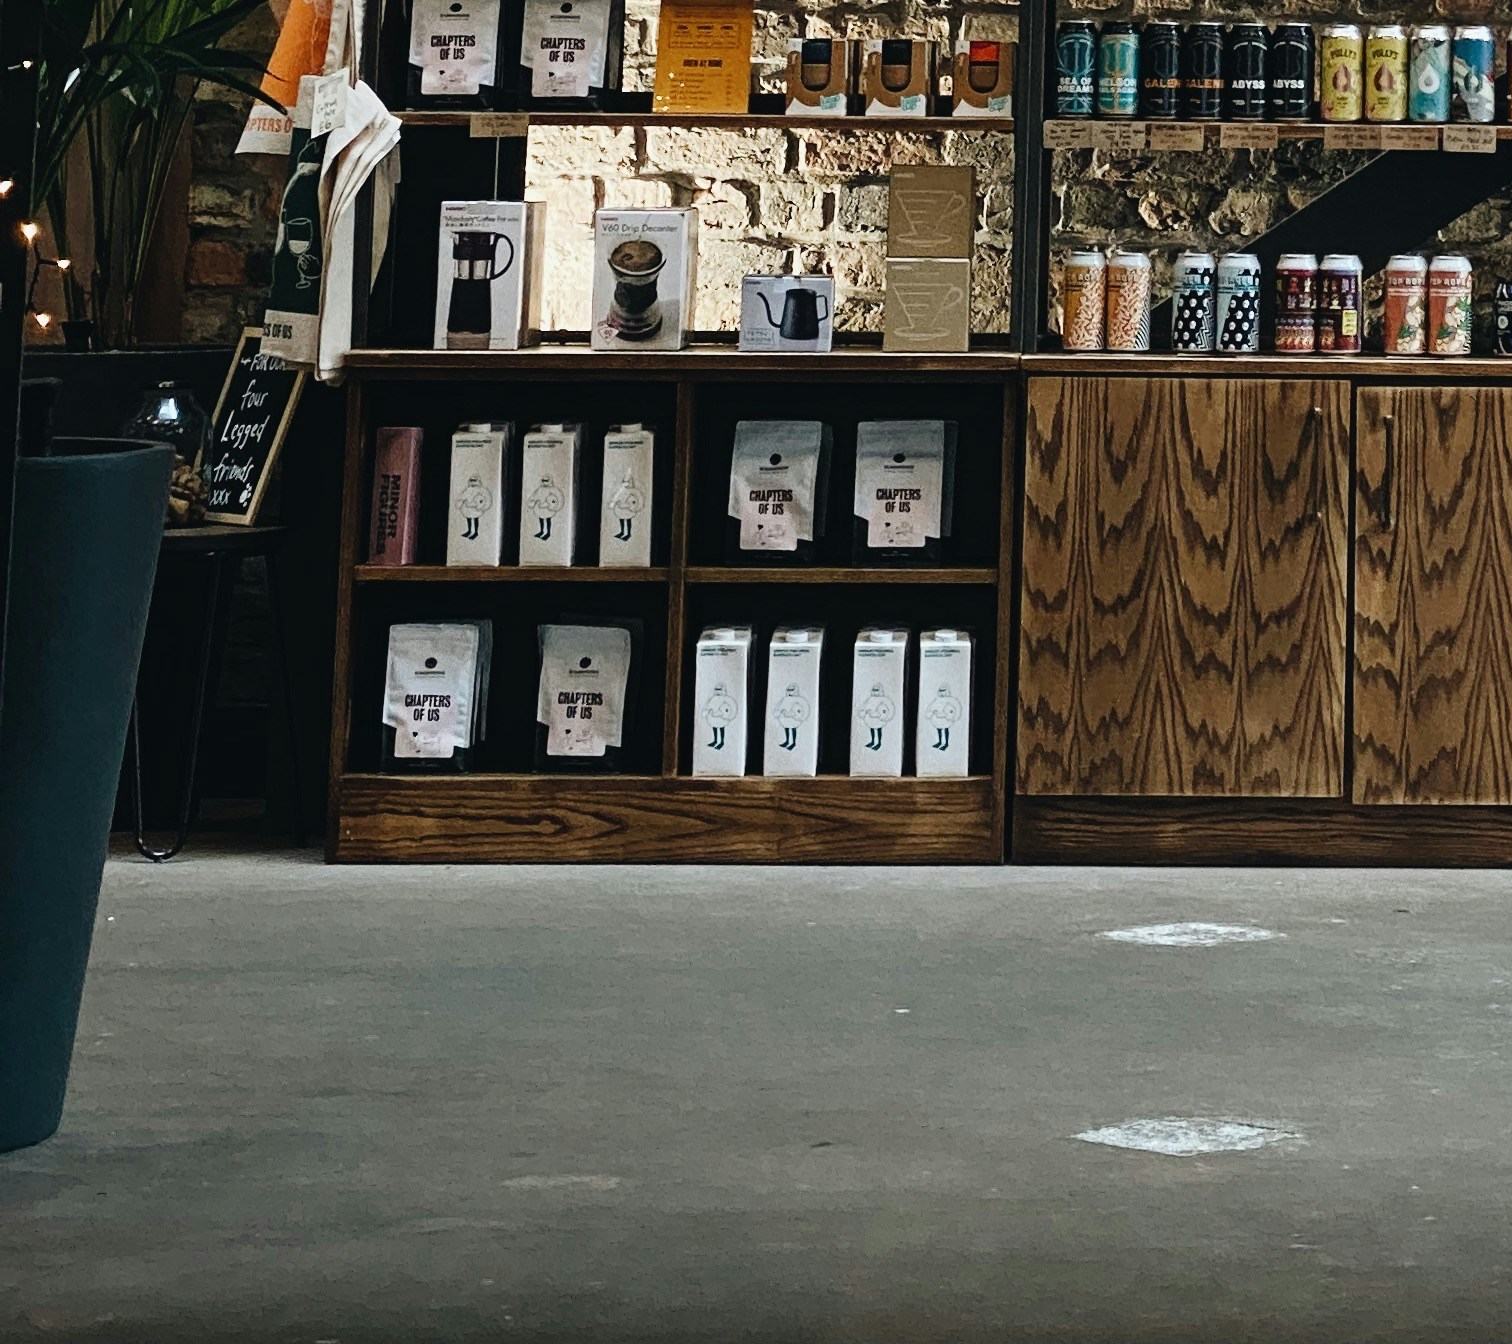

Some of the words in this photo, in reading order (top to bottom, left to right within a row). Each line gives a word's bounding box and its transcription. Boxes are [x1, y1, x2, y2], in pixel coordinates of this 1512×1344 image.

[430, 35, 476, 48] CHAPTERS
[540, 37, 585, 51] CHAPTERS
[440, 49, 450, 60] OF
[453, 48, 465, 60] US
[549, 50, 560, 62] OF
[563, 50, 574, 62] US
[1059, 77, 1077, 85] SEA
[1232, 79, 1265, 90] ABYSS
[1273, 79, 1305, 90] ABYSS
[1057, 85, 1094, 94] DREAMS
[247, 117, 281, 132] PTERS
[602, 223, 619, 232] V60
[220, 410, 270, 449] Legged
[213, 452, 254, 483] friends
[749, 489, 793, 502] CHAPTERS
[876, 489, 921, 500] CHAPTERS
[387, 474, 400, 539] MINOR
[758, 503, 769, 515] OF
[772, 503, 784, 515] US
[885, 501, 895, 513] OF
[899, 501, 910, 513] US
[405, 694, 451, 707] CHAPTERS
[558, 692, 603, 705] CHAPTERS
[413, 708, 424, 721] OF
[428, 708, 440, 721] US
[566, 706, 577, 719] OF
[580, 706, 592, 719] US
